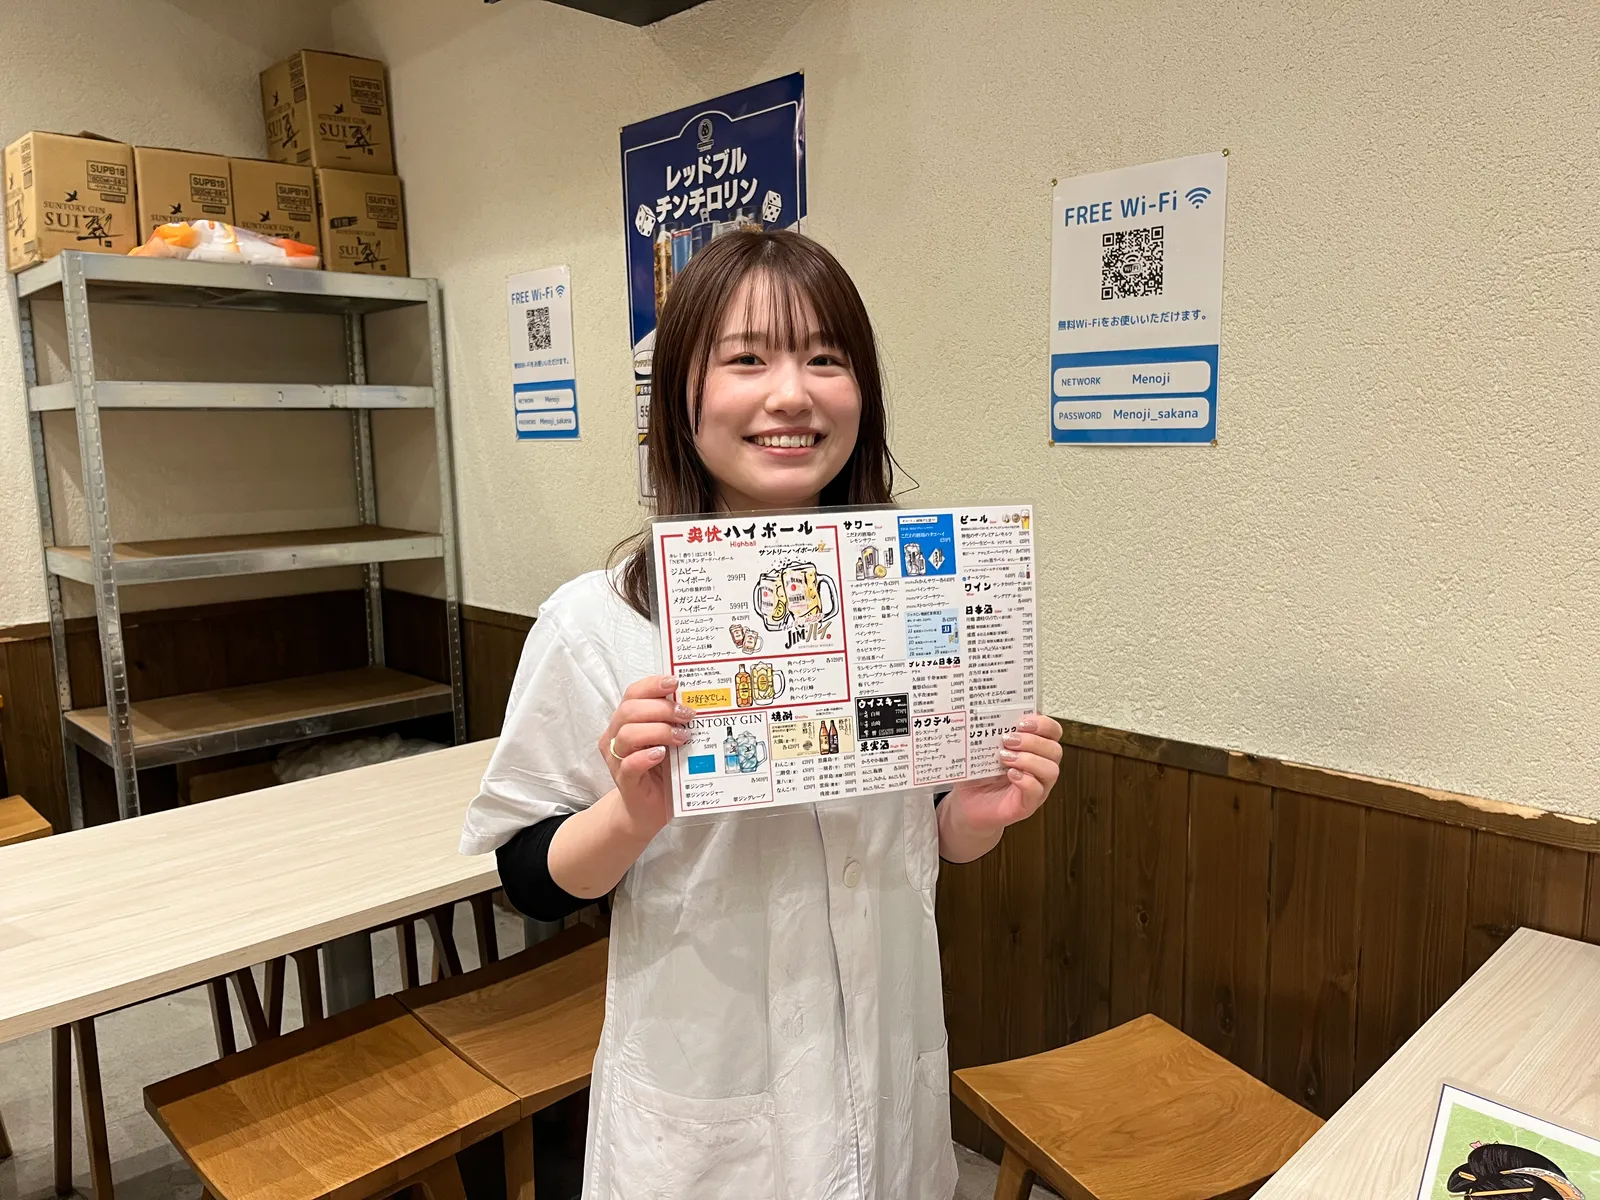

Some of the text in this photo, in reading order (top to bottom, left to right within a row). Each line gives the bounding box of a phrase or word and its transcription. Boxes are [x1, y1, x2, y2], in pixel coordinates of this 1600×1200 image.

[320, 123, 347, 137] SUI
[90, 164, 126, 177] SUPB18
[666, 147, 748, 192] レッドブル
[192, 176, 226, 189] SUPB18
[279, 186, 309, 197] SUPB18
[655, 178, 758, 221] チンチロリン
[43, 201, 106, 215] SUNTORY GIN
[1064, 190, 1178, 227] FREE Wi-Fi
[44, 212, 80, 229] SUI
[242, 221, 277, 230] SUNTORY
[339, 245, 359, 256] SUI
[512, 286, 554, 306] FREE Wi-Fi
[1057, 310, 1207, 332] 無料Wi-Fiをお使いいただけます。
[1061, 372, 1171, 388] NETWORK Menoji
[545, 396, 560, 405] Menoji
[1058, 408, 1199, 422] PASSWORD Menoji_sakana
[540, 418, 572, 426] Menoji_sakana
[960, 514, 988, 525] ビール
[843, 520, 874, 531] サワー
[687, 520, 813, 543] 爽快ハイボール
[730, 540, 757, 548] Highball
[758, 546, 820, 557] サントリーハイボール
[670, 566, 707, 576] ジムビーム
[677, 573, 746, 585] ハイボール 299円
[964, 582, 992, 592] ワイン
[673, 594, 722, 605] メガジムビーム
[679, 602, 749, 613] ハイボール 599円
[966, 604, 993, 615] 日本酒
[674, 617, 714, 626] ジムビームコーラ
[676, 626, 725, 635] ジムビームジンジャー
[676, 635, 716, 643] ジムビームレモン
[678, 651, 737, 661] ジムビームシークワーサー
[787, 659, 815, 667] 角ハイコーラ
[908, 656, 961, 668] プレミアム日本酒
[788, 667, 825, 675] 角ハイジンジャー
[680, 680, 713, 688] 角ハイボール
[788, 676, 817, 684] 角ハイレモン
[790, 692, 837, 701] 角ハイシークワーサー
[858, 698, 901, 709] ウイスキー
[740, 714, 763, 725] GIN
[772, 710, 793, 722] 焼酎
[914, 716, 951, 729] カクテル
[970, 726, 1017, 739] ソフトドリンク
[860, 740, 890, 752] 果実酒
